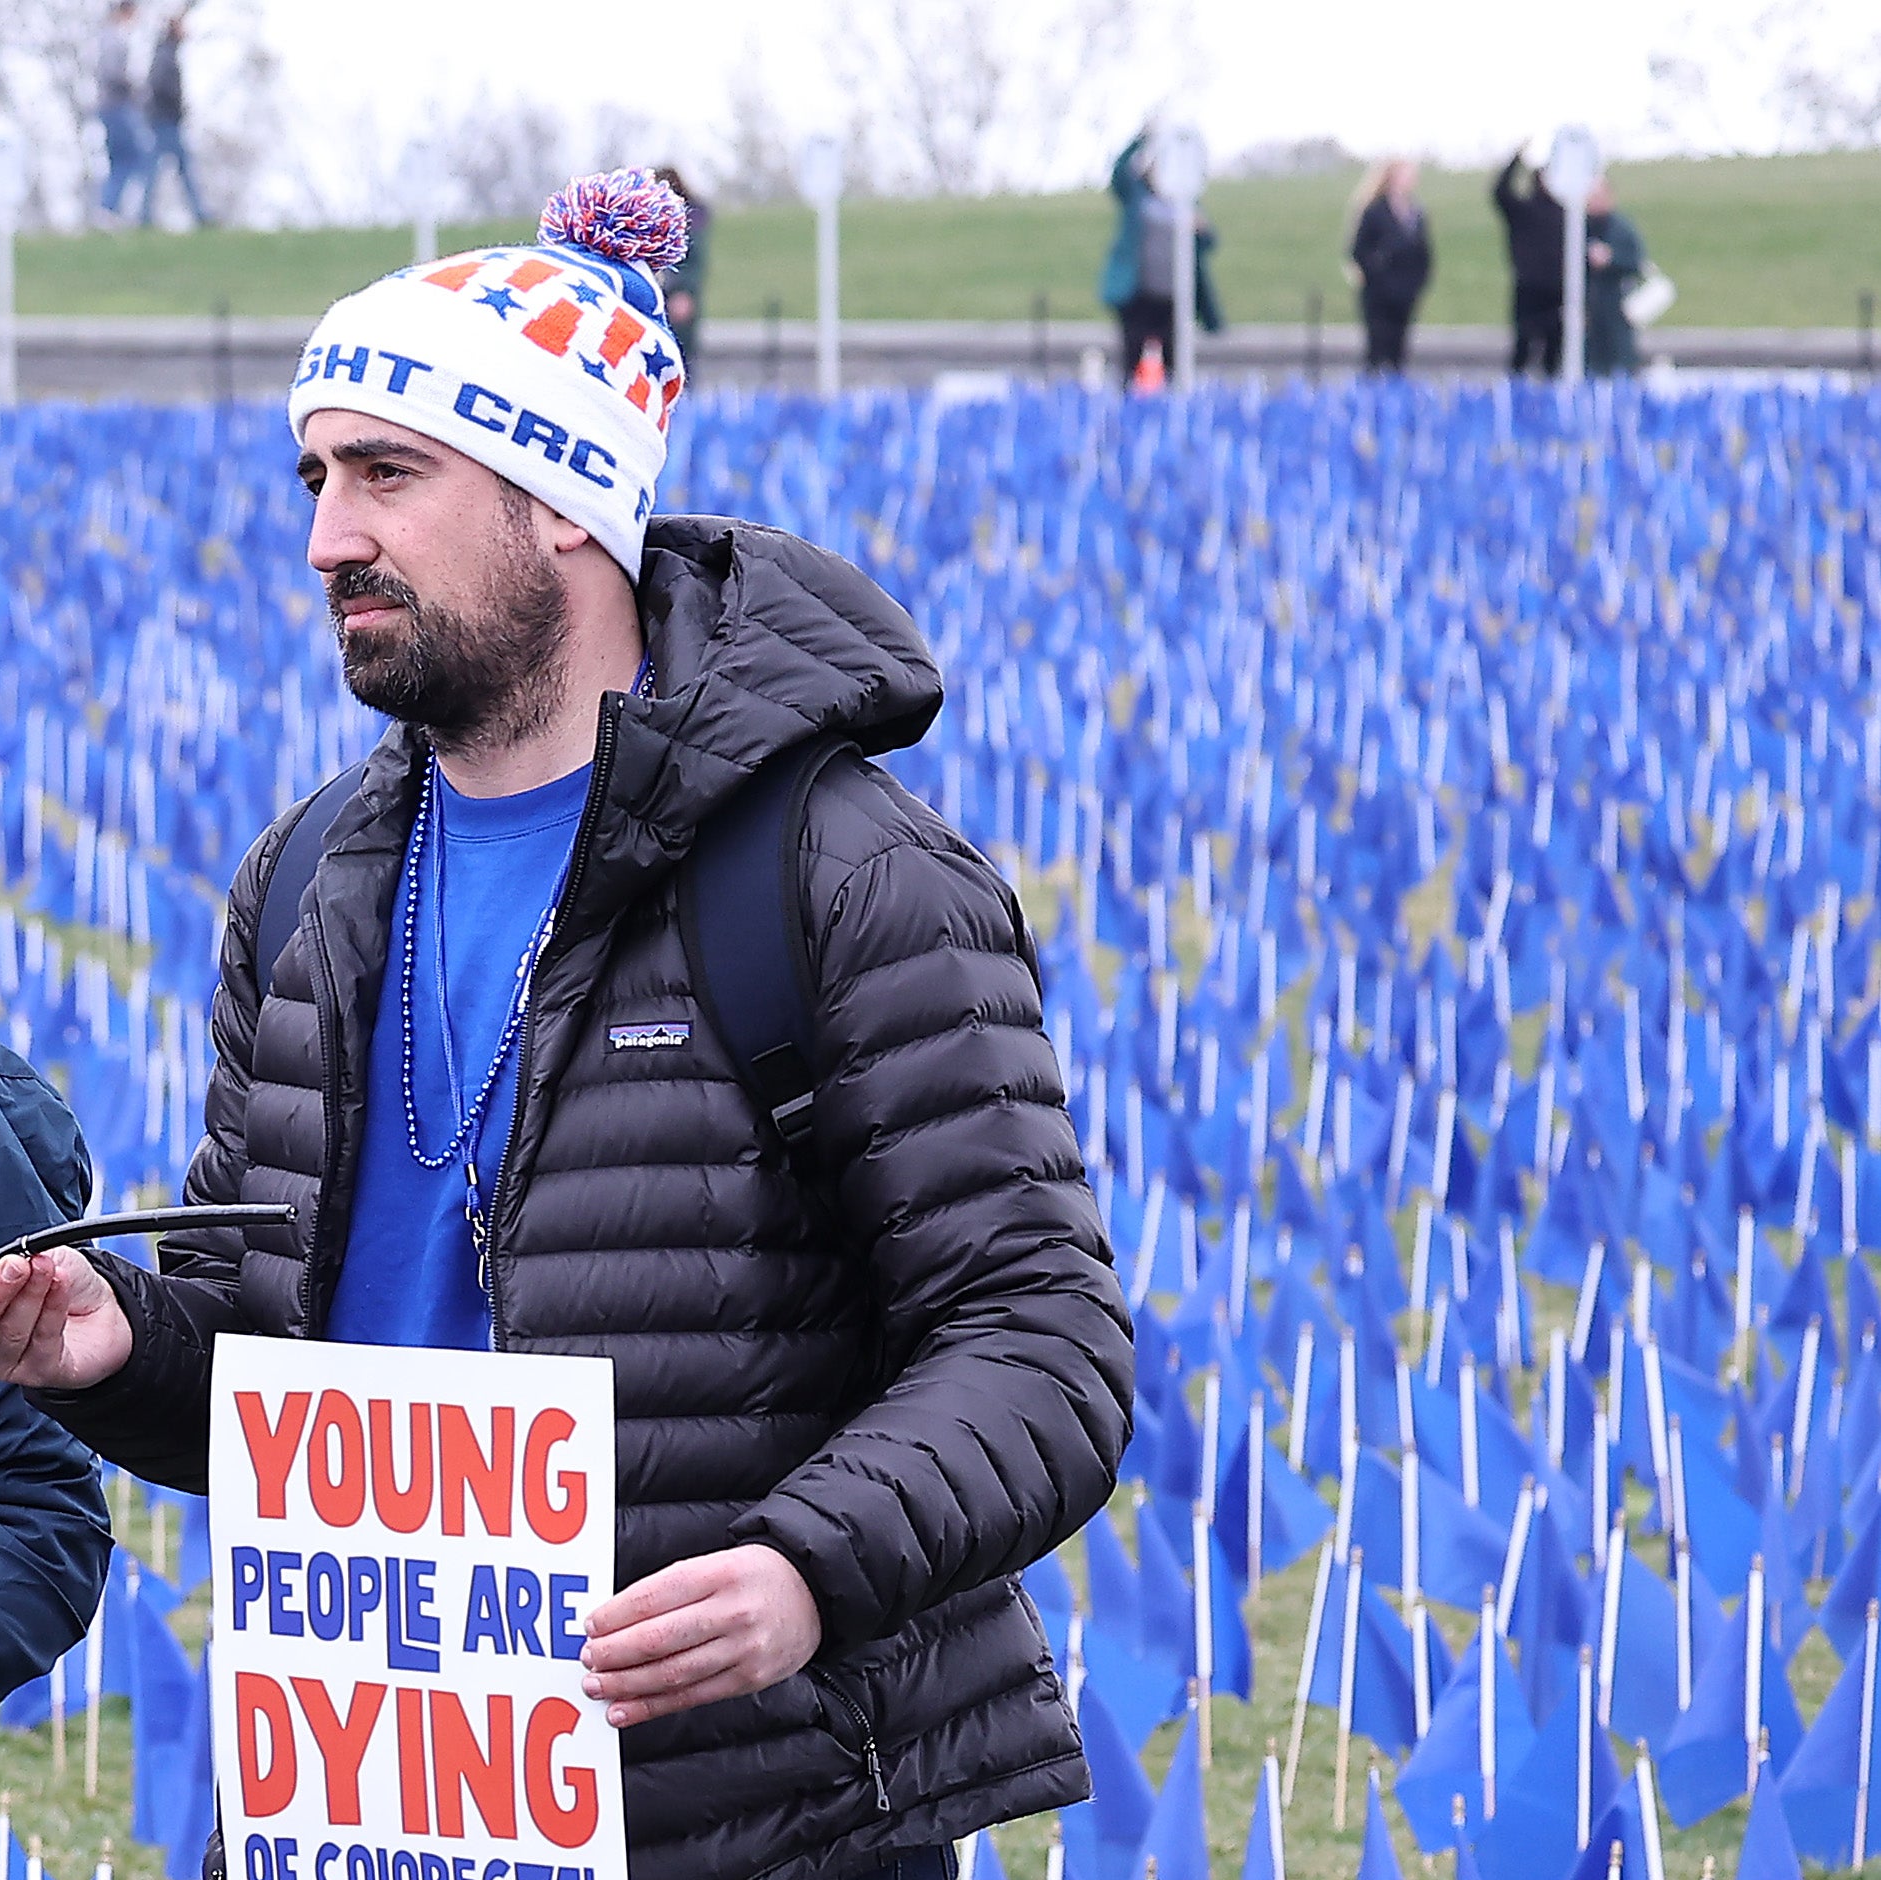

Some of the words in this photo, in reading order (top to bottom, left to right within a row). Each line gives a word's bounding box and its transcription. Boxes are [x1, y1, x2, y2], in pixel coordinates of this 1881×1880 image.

[294, 344, 433, 395] GHT
[453, 382, 617, 490] CRC
[615, 1034, 685, 1050] patagonia
[233, 1388, 587, 1545] YOUNG
[232, 1545, 439, 1673] PEOPLE
[463, 1564, 589, 1660] ARE
[236, 1671, 598, 1849] DYING
